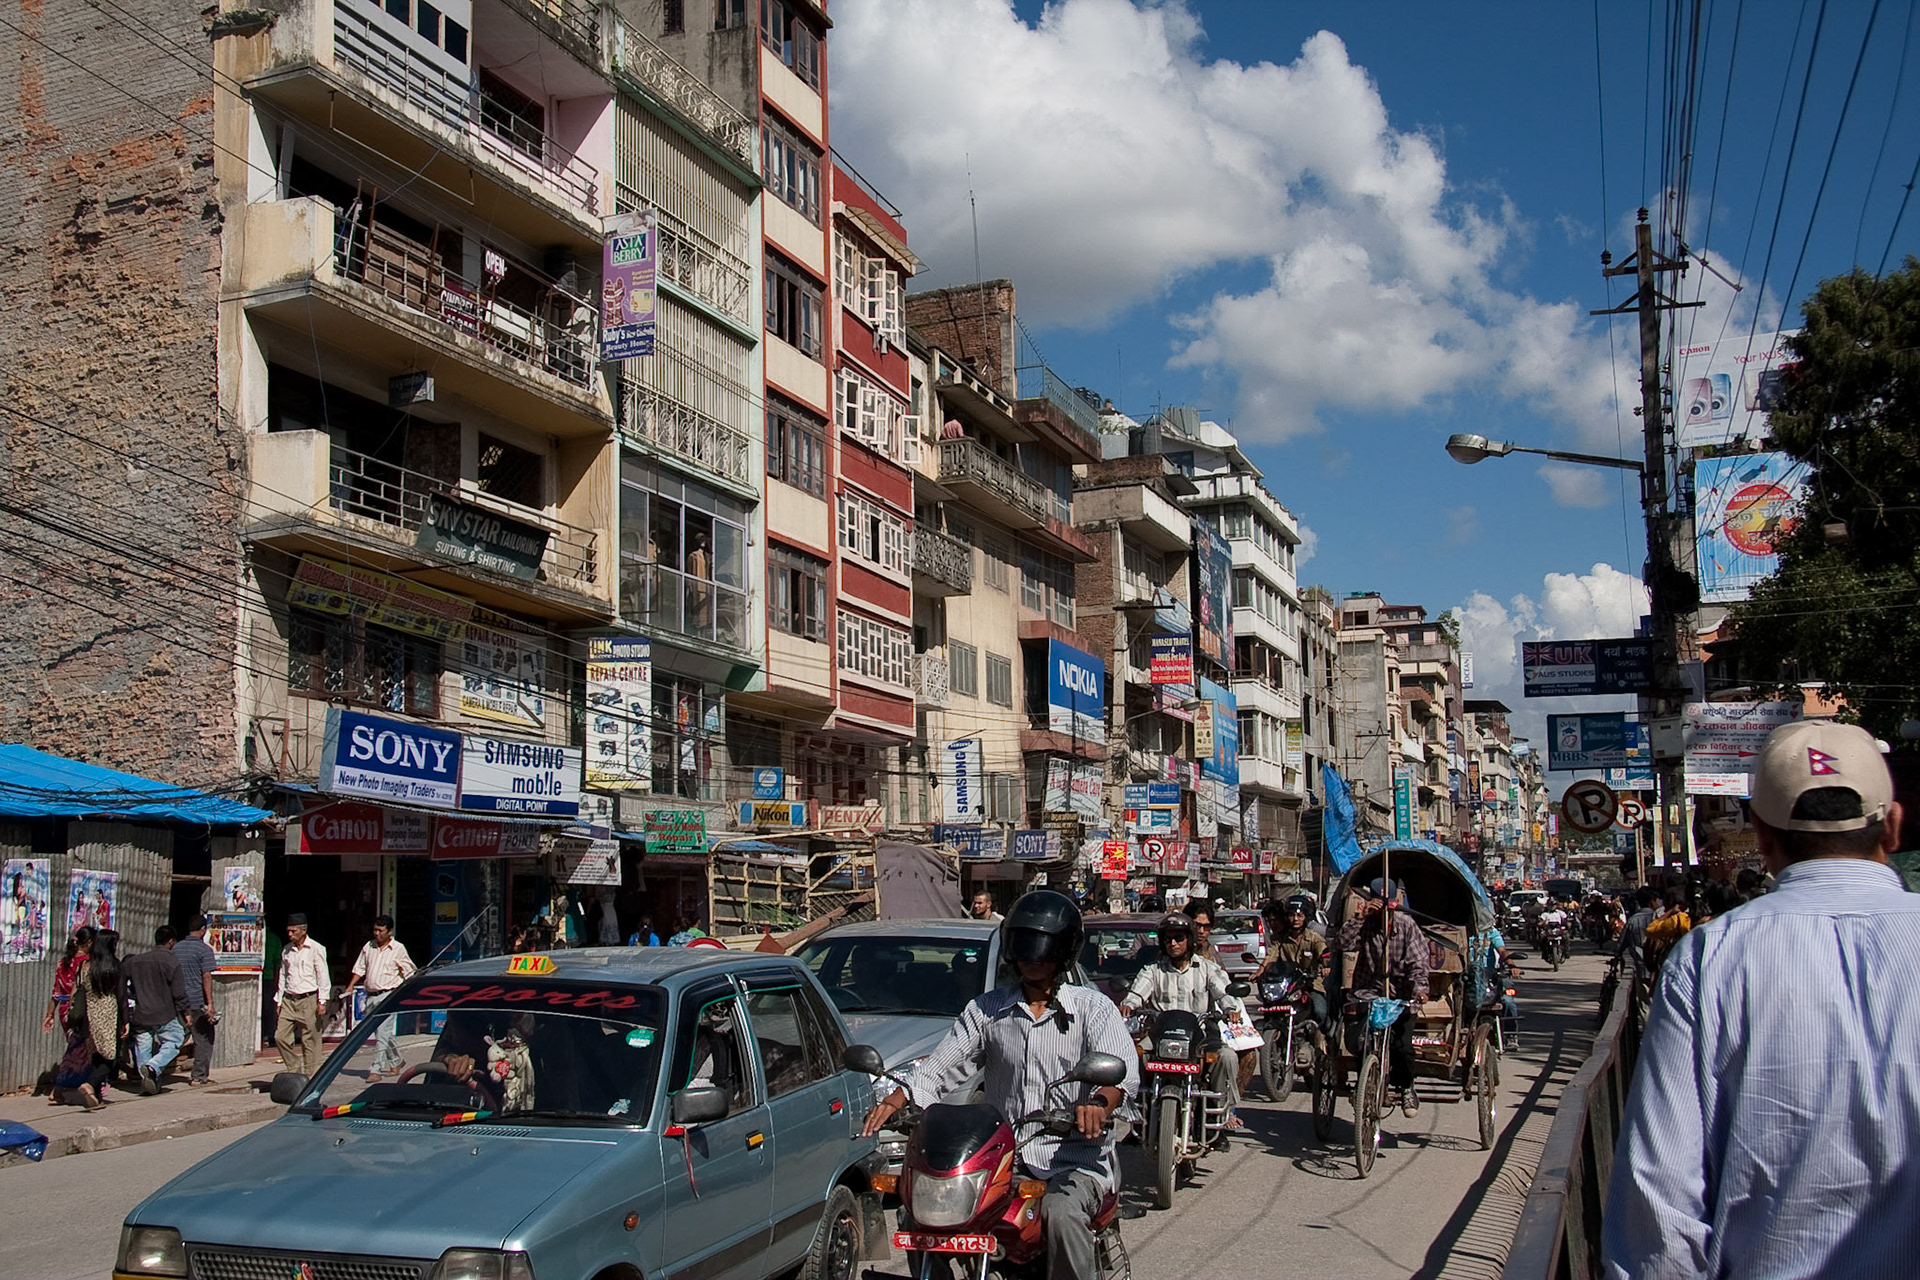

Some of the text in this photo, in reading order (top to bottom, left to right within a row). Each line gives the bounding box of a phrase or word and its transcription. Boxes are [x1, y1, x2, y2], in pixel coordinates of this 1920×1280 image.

[615, 235, 643, 250] ASTA
[613, 246, 645, 263] BERRY
[486, 250, 505, 277] OPEN
[603, 328, 625, 343] Ruby's
[605, 343, 629, 352] Beauty
[1679, 344, 1710, 356] Canon
[1733, 351, 1757, 364] Your
[427, 501, 540, 556] SKY STAR TAILORING
[435, 540, 516, 573] SUITING & SHIRTING
[465, 625, 517, 649] REPAIR CENTRE
[1555, 646, 1593, 665] UK
[590, 666, 647, 681] REPAIR CENTRE
[1059, 659, 1098, 699] NOKIA
[1538, 670, 1556, 678] AUS
[1558, 669, 1594, 677] STUDIES
[1704, 722, 1736, 731] रक्तदान
[349, 725, 453, 774] SONY
[485, 740, 564, 770] SAMSUNG
[1551, 751, 1589, 762] MBBS
[338, 770, 436, 798] New Photo Imaging Traders
[955, 751, 969, 813] SAMSUNG
[1607, 779, 1631, 787] MBBS
[496, 798, 549, 812] DIGITAL POINT
[390, 816, 420, 826] New Photo
[753, 807, 789, 822] Nikon
[825, 809, 883, 824] PENTAX
[307, 814, 379, 840] Canon
[383, 828, 427, 841] Imaging Traders
[503, 822, 539, 833] DIGITAL
[438, 825, 498, 848] Canon
[506, 834, 535, 847] POINT
[658, 833, 693, 842] Repair
[943, 829, 980, 851] SONY
[1016, 835, 1046, 853] SONY
[513, 957, 547, 971] TAXI
[400, 984, 642, 1009] Sports
